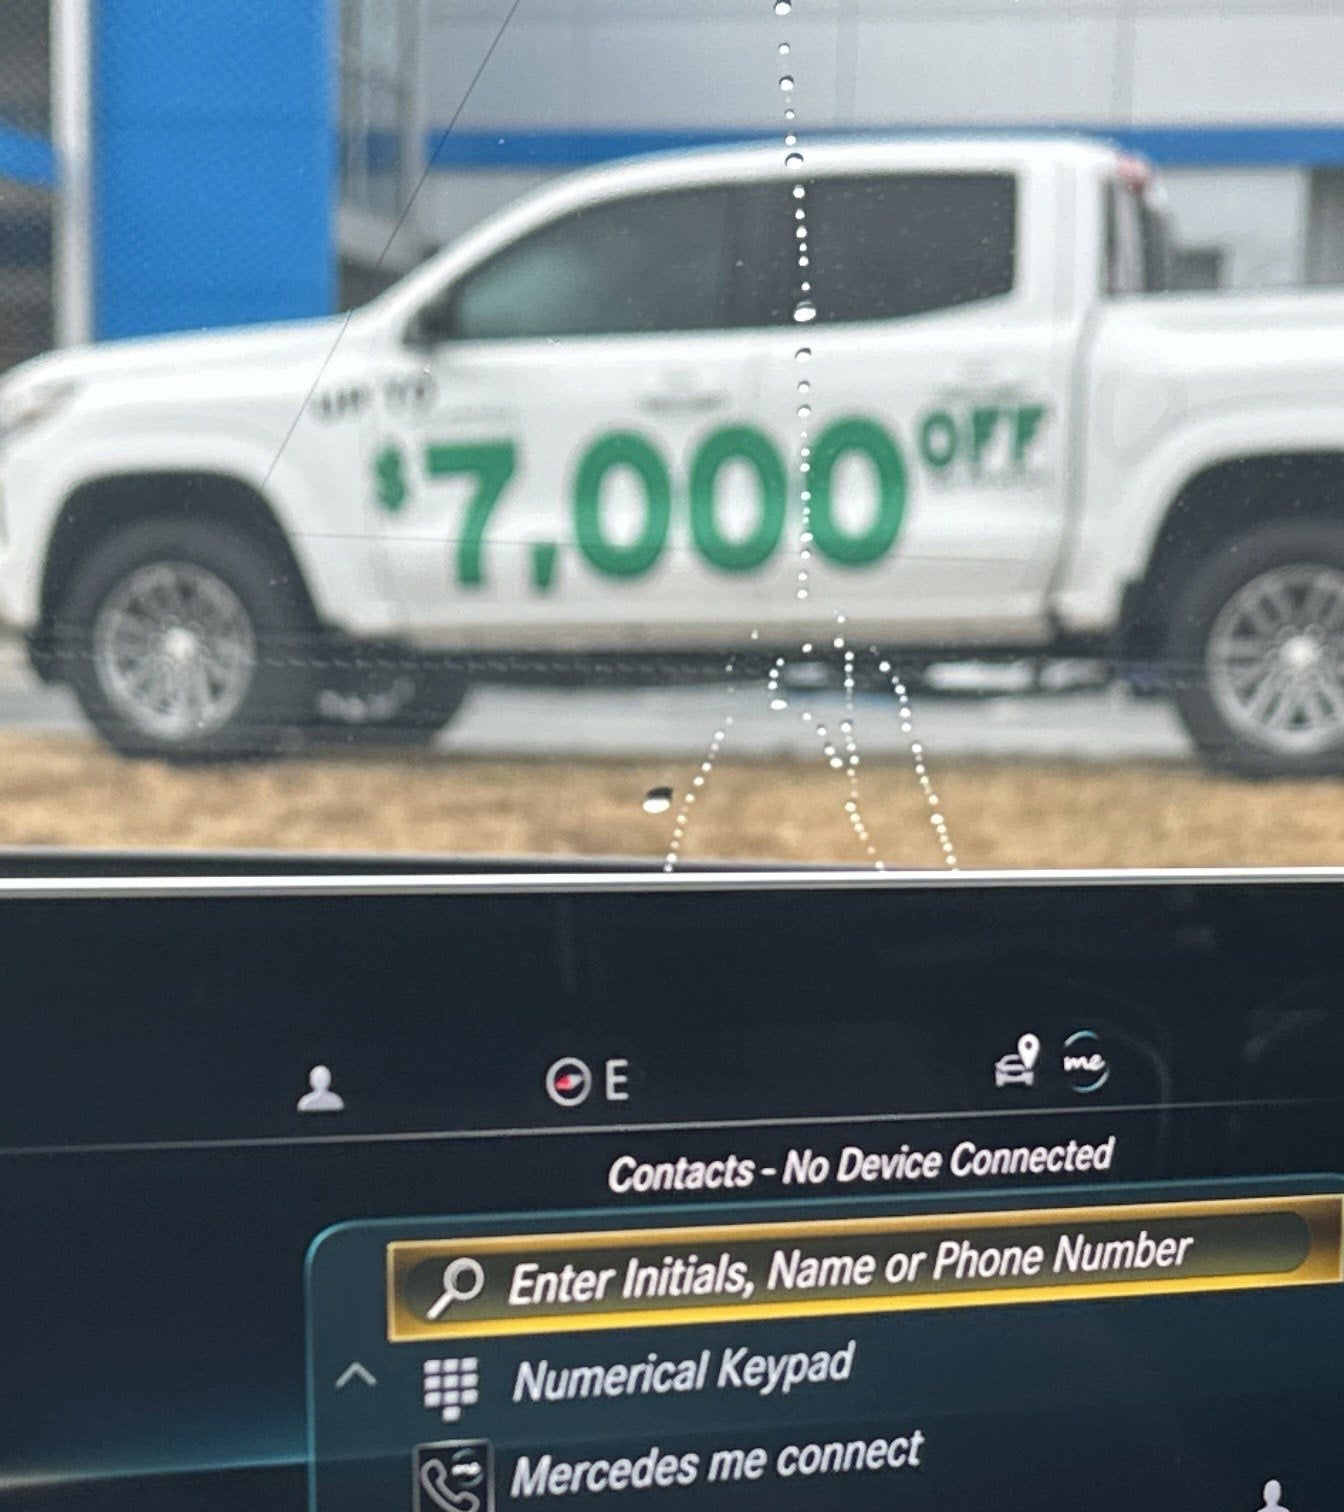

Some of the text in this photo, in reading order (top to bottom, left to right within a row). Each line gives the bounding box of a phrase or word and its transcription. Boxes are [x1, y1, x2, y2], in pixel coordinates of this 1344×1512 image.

[372, 403, 1052, 592] $7,000 OFF
[605, 1058, 630, 1101] E
[607, 1154, 756, 1194] Contacts
[782, 1148, 830, 1185] No
[836, 1143, 943, 1184] Device
[949, 1135, 1117, 1178] Connected
[507, 1230, 1195, 1306] Enter Initials, Name or Phone Number
[511, 1339, 858, 1403] Numerical Keypad
[509, 1429, 927, 1499] Mercedes me connect
